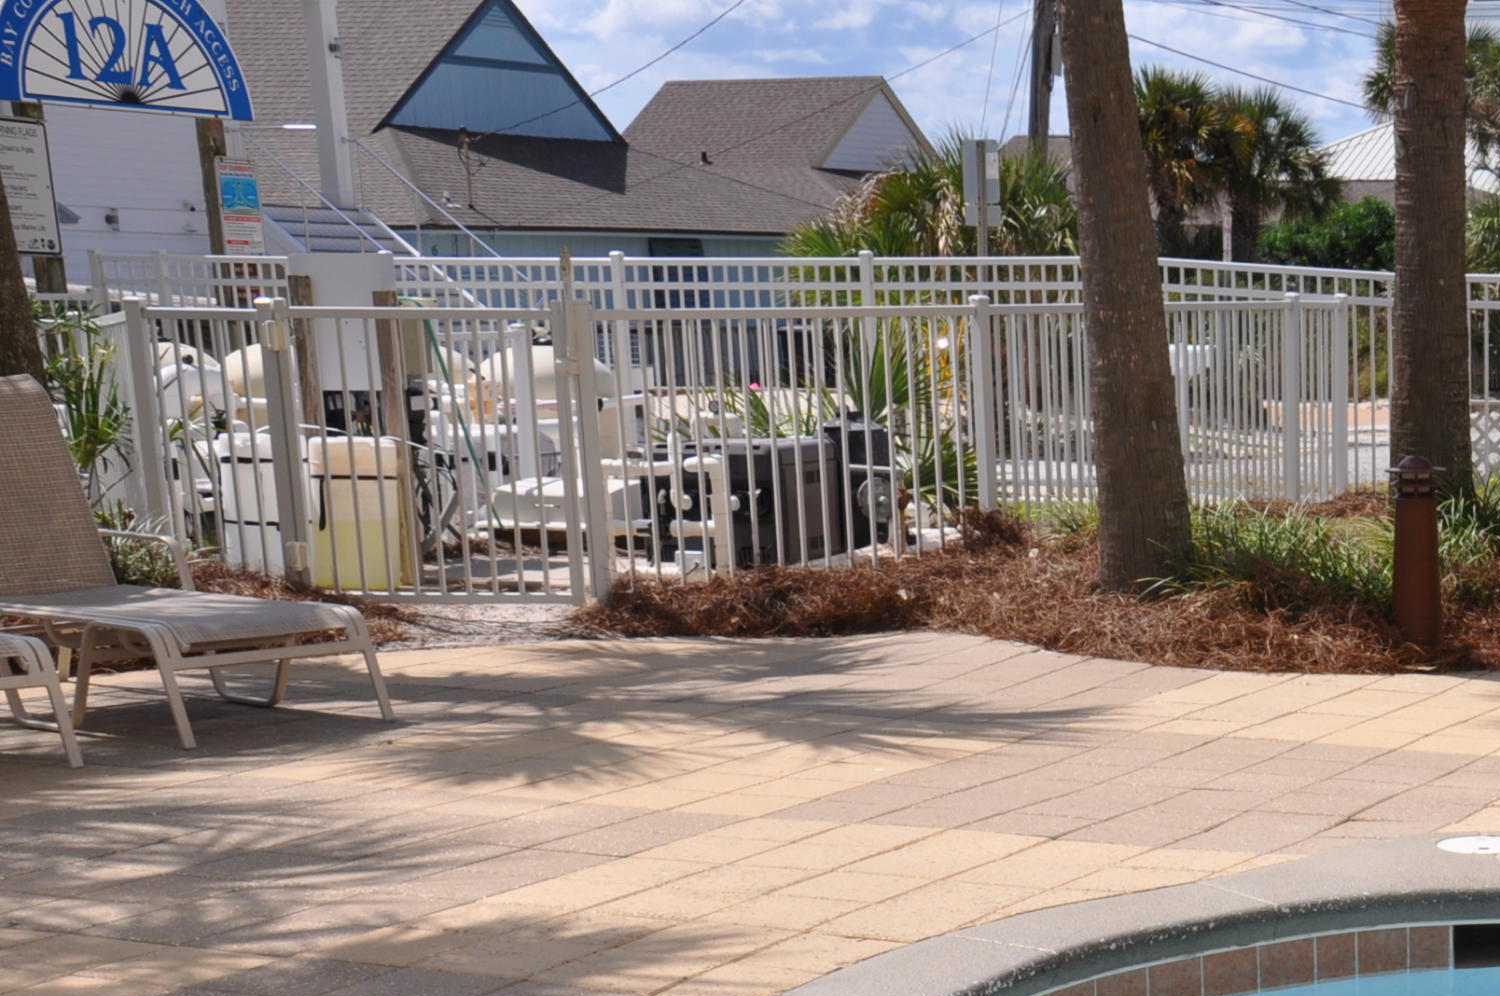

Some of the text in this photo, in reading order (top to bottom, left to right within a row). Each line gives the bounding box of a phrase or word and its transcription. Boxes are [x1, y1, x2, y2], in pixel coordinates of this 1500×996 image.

[0, 21, 18, 67] BAY
[193, 19, 240, 92] ACCESS
[56, 11, 187, 90] 12A
[431, 244, 438, 256] 6
